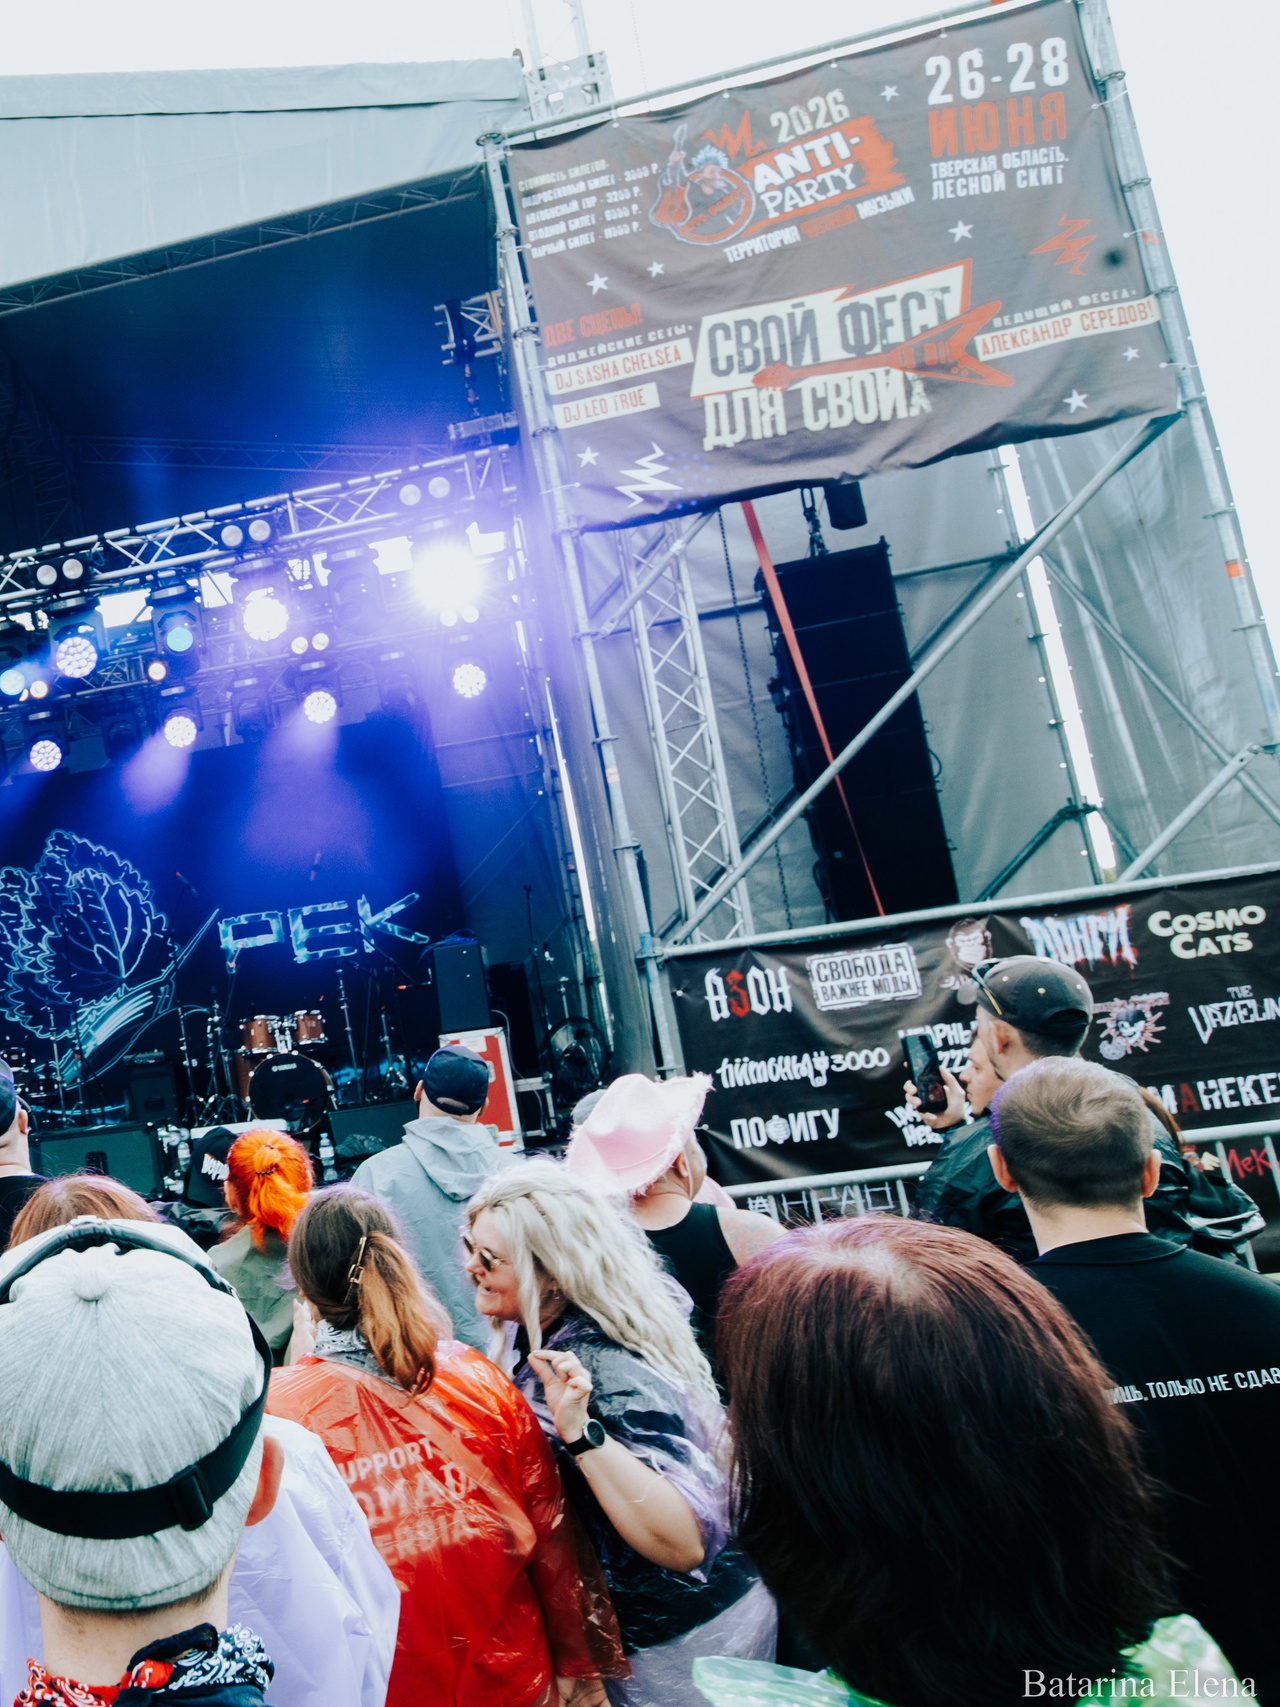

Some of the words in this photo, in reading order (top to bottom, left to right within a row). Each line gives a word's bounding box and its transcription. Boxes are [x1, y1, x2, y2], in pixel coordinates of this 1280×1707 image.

[925, 37, 1069, 106] 26-28
[770, 88, 850, 143] 2026
[928, 91, 1067, 158] ИЮНЯ
[753, 130, 861, 194] ANTI-
[930, 155, 997, 180] ТВЕРСКАЯ
[932, 170, 1006, 200] ЛЕСНОЙ
[1016, 165, 1064, 189] СКИТ
[759, 163, 856, 218] PARTY
[723, 225, 801, 263] ТЕРРИТОРИЯ
[856, 186, 915, 219] МУЗЫКИ
[707, 302, 821, 378] СВОЙ
[837, 286, 952, 354] ФЕСТ
[981, 317, 1072, 356] АЛЕКСАНДР
[555, 371, 573, 391] DJ
[576, 360, 620, 386] SASHA
[622, 345, 682, 374] CHELSEA
[563, 403, 581, 423] DJ
[584, 398, 609, 419] LEO
[613, 388, 646, 412] TRUE
[703, 387, 788, 452] ДЛЯ
[1147, 905, 1267, 938] COSMO
[1170, 932, 1254, 960] CATS
[817, 952, 907, 983] СВОБОДА
[821, 980, 869, 1002] ВАЖНЕЕ
[872, 975, 912, 996] МОДЫ
[1226, 985, 1253, 999] THE
[830, 1047, 891, 1072] 3000
[1146, 1072, 1280, 1114] МАНЕКЕ
[1145, 1378, 1206, 1399] ТОЛЬКО
[1207, 1374, 1233, 1392] НЕ
[337, 1437, 436, 1484] UPPORT
[355, 1462, 471, 1524] OMAD
